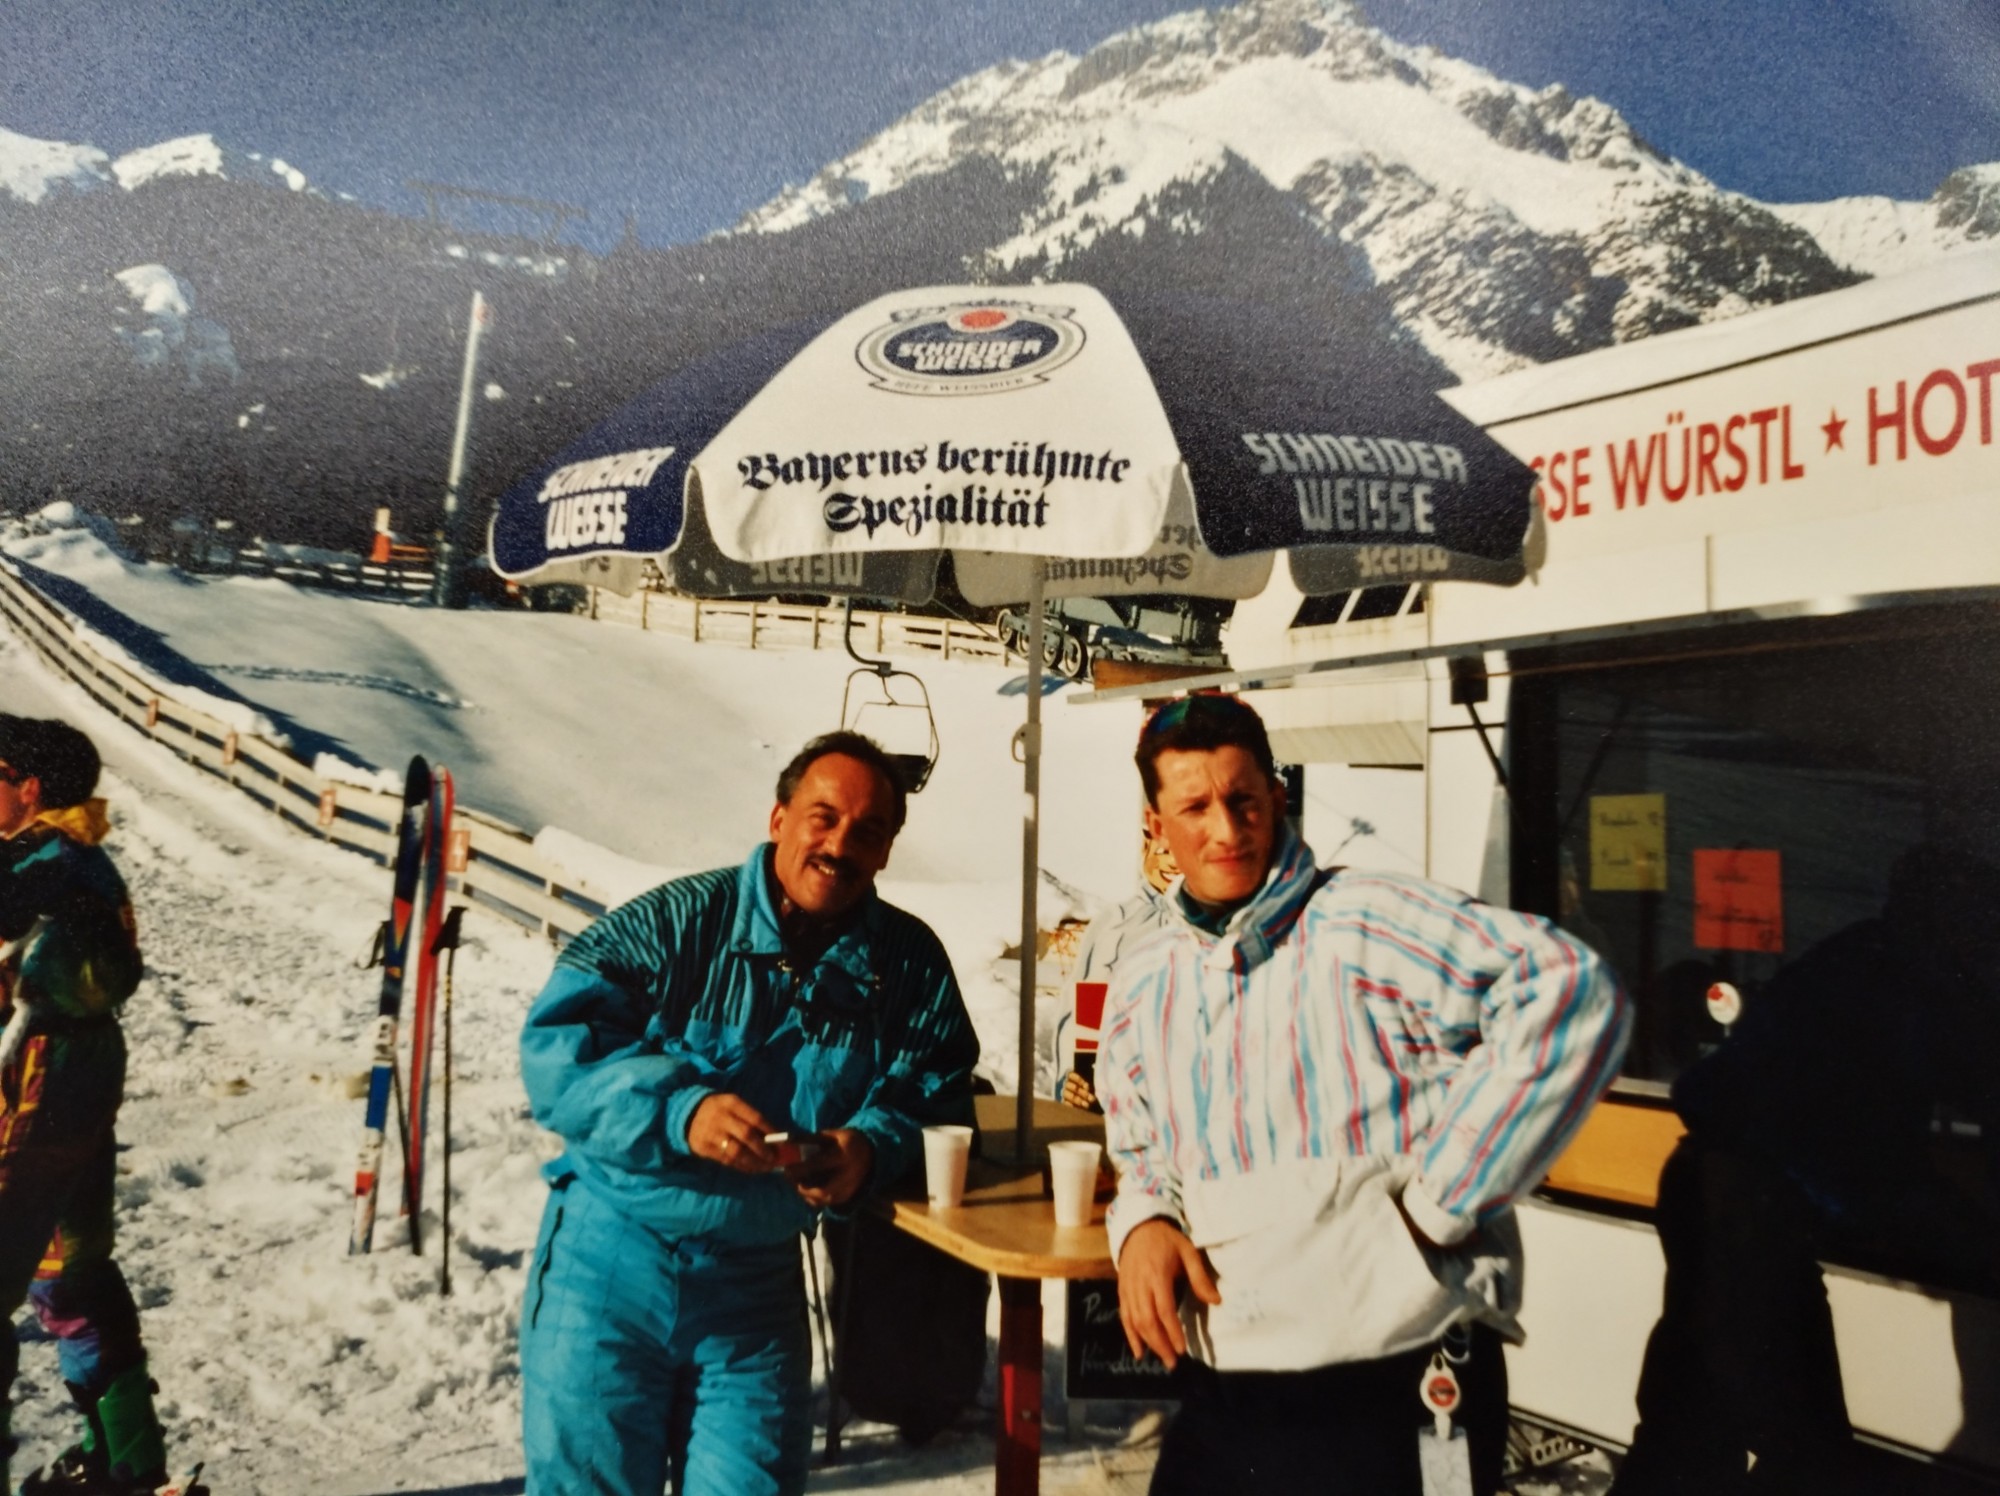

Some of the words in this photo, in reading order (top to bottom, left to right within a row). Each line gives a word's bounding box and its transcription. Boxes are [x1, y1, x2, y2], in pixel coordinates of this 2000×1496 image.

[914, 353, 1014, 371] WEISSE
[1241, 432, 1468, 485] SCHNEIDER
[1606, 404, 1804, 510] WÜRSTL
[1867, 358, 2000, 466] HOT
[737, 442, 928, 492] Bayerns
[936, 440, 1131, 488] berühmte
[823, 483, 1050, 540] Spezialität
[1294, 477, 1436, 534] WEISSE
